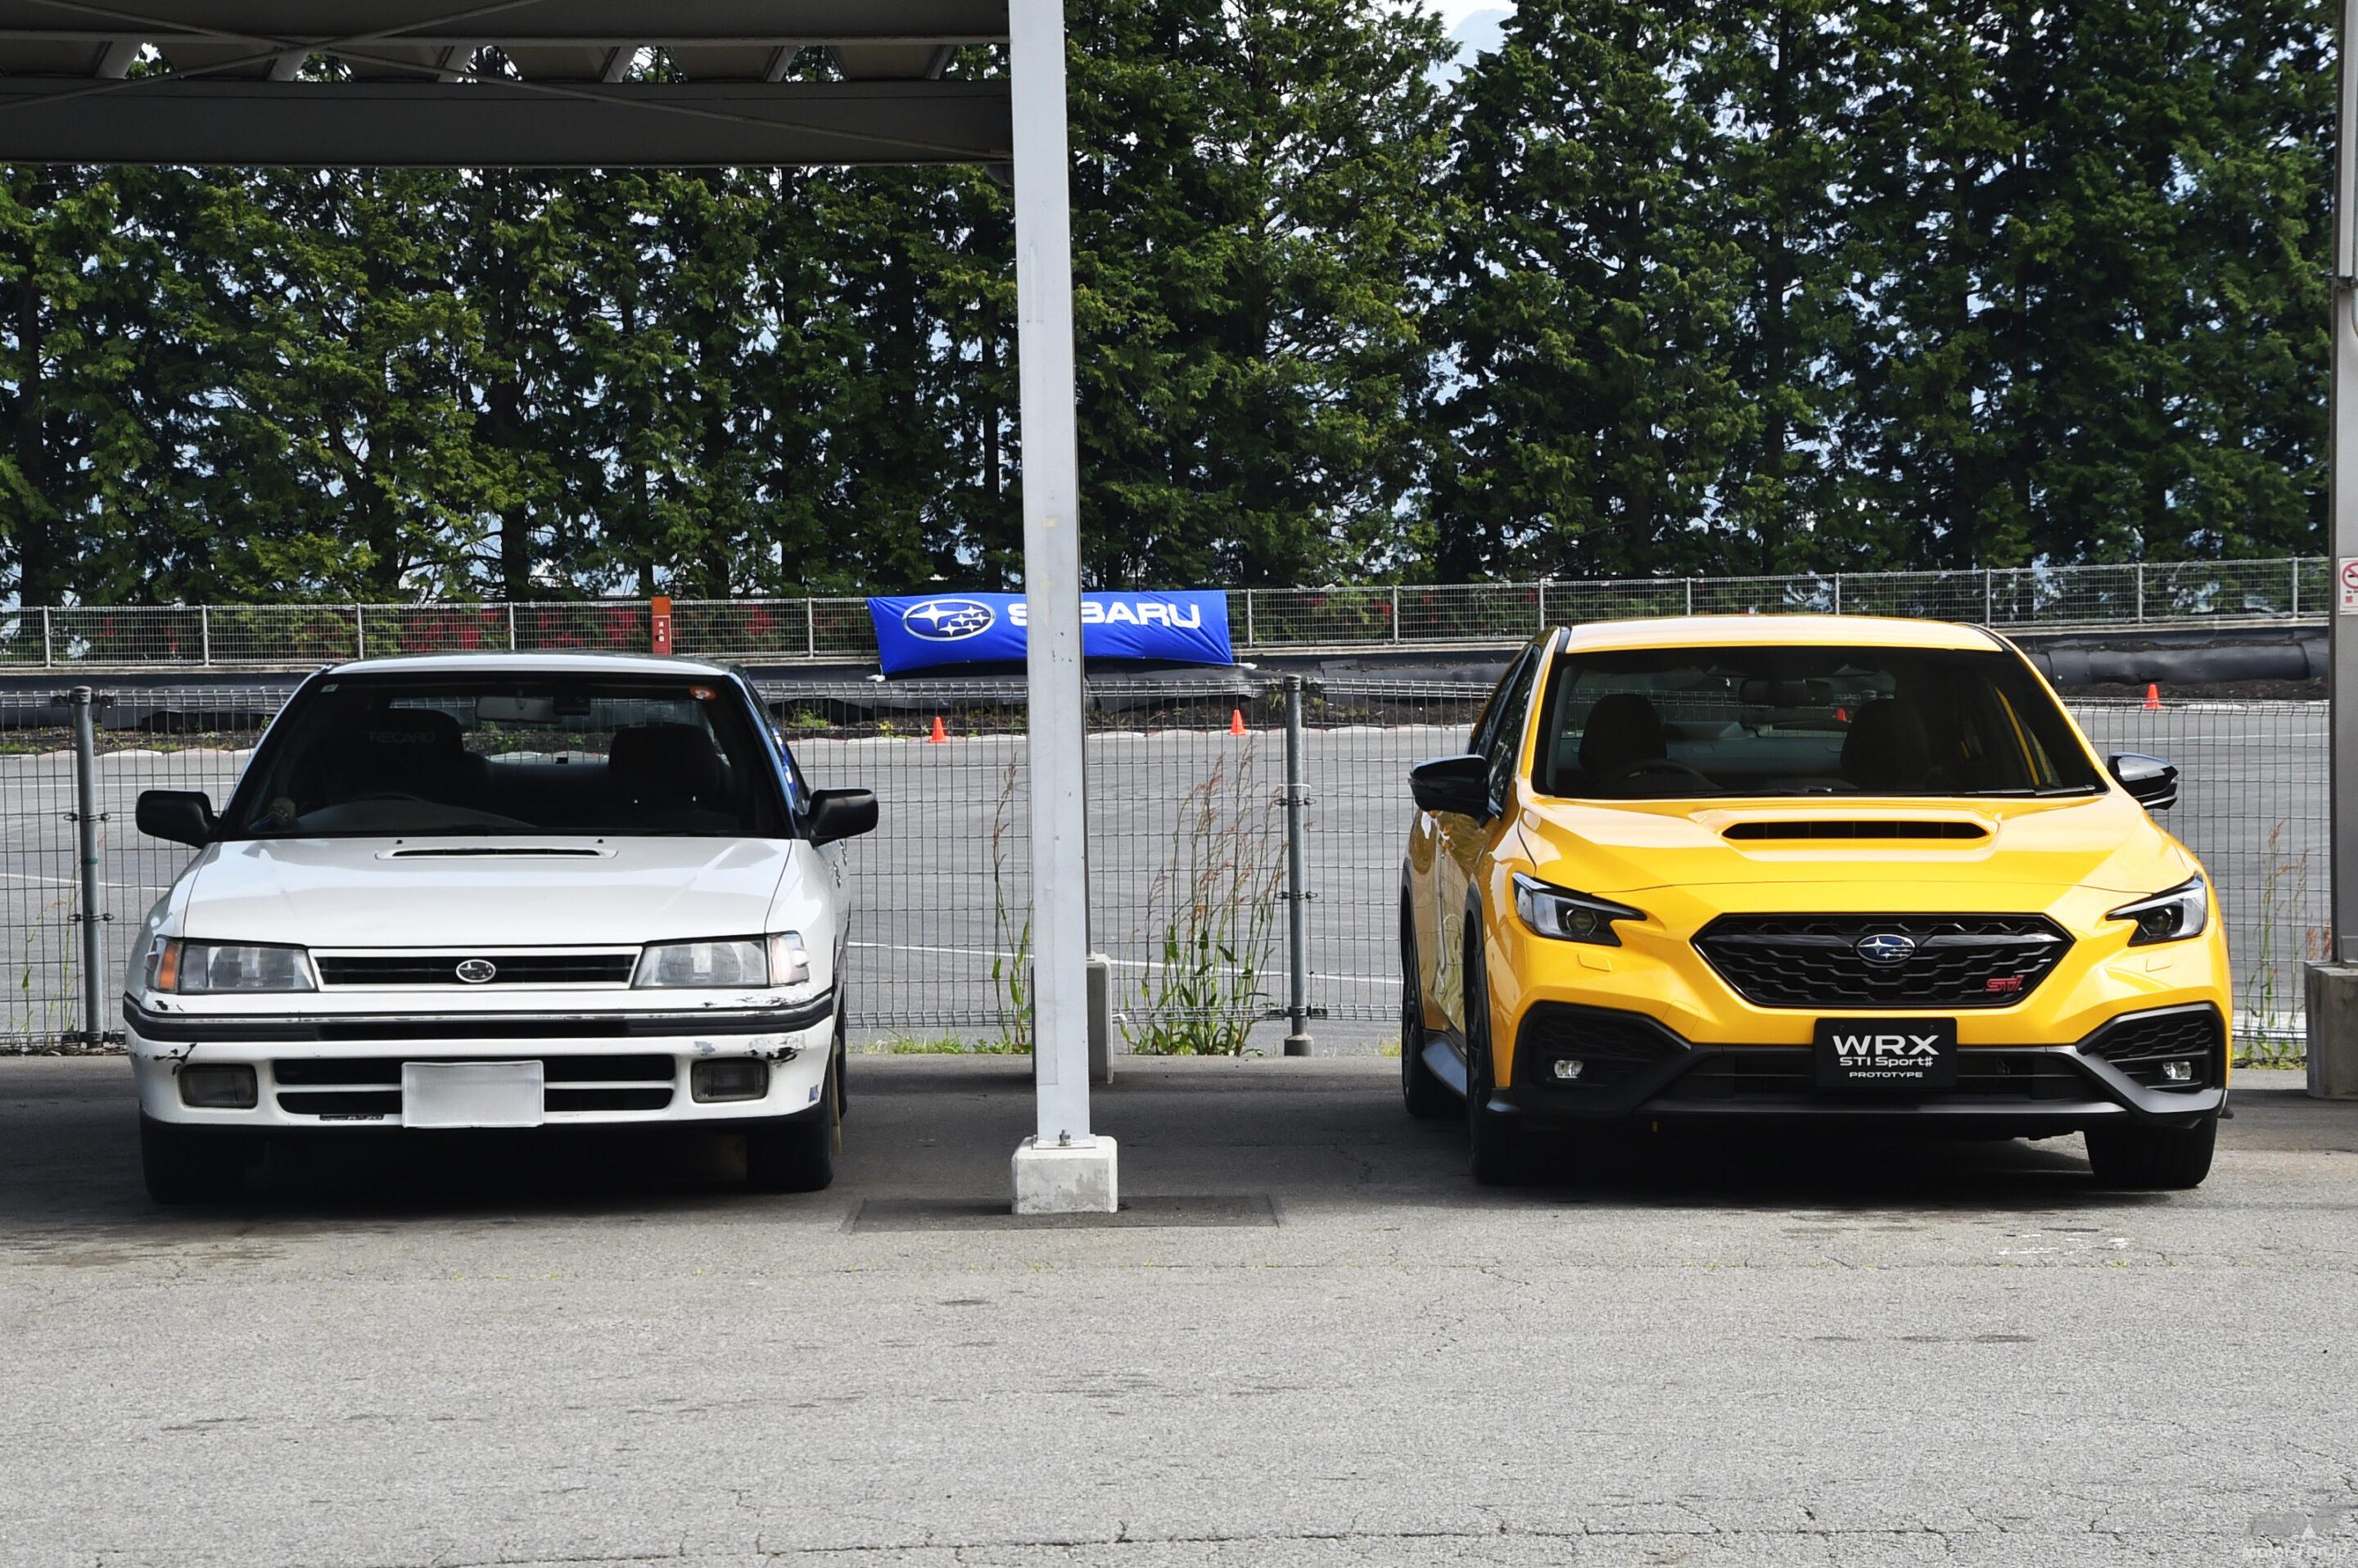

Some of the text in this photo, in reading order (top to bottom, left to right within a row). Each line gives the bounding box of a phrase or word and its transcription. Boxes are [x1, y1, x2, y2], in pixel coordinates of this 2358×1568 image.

[1008, 601, 1200, 630] SBARU
[368, 730, 436, 744] RECARO
[1985, 974, 2025, 992] STI
[1832, 1035, 1940, 1055] WRX
[1839, 1056, 1871, 1066] STI
